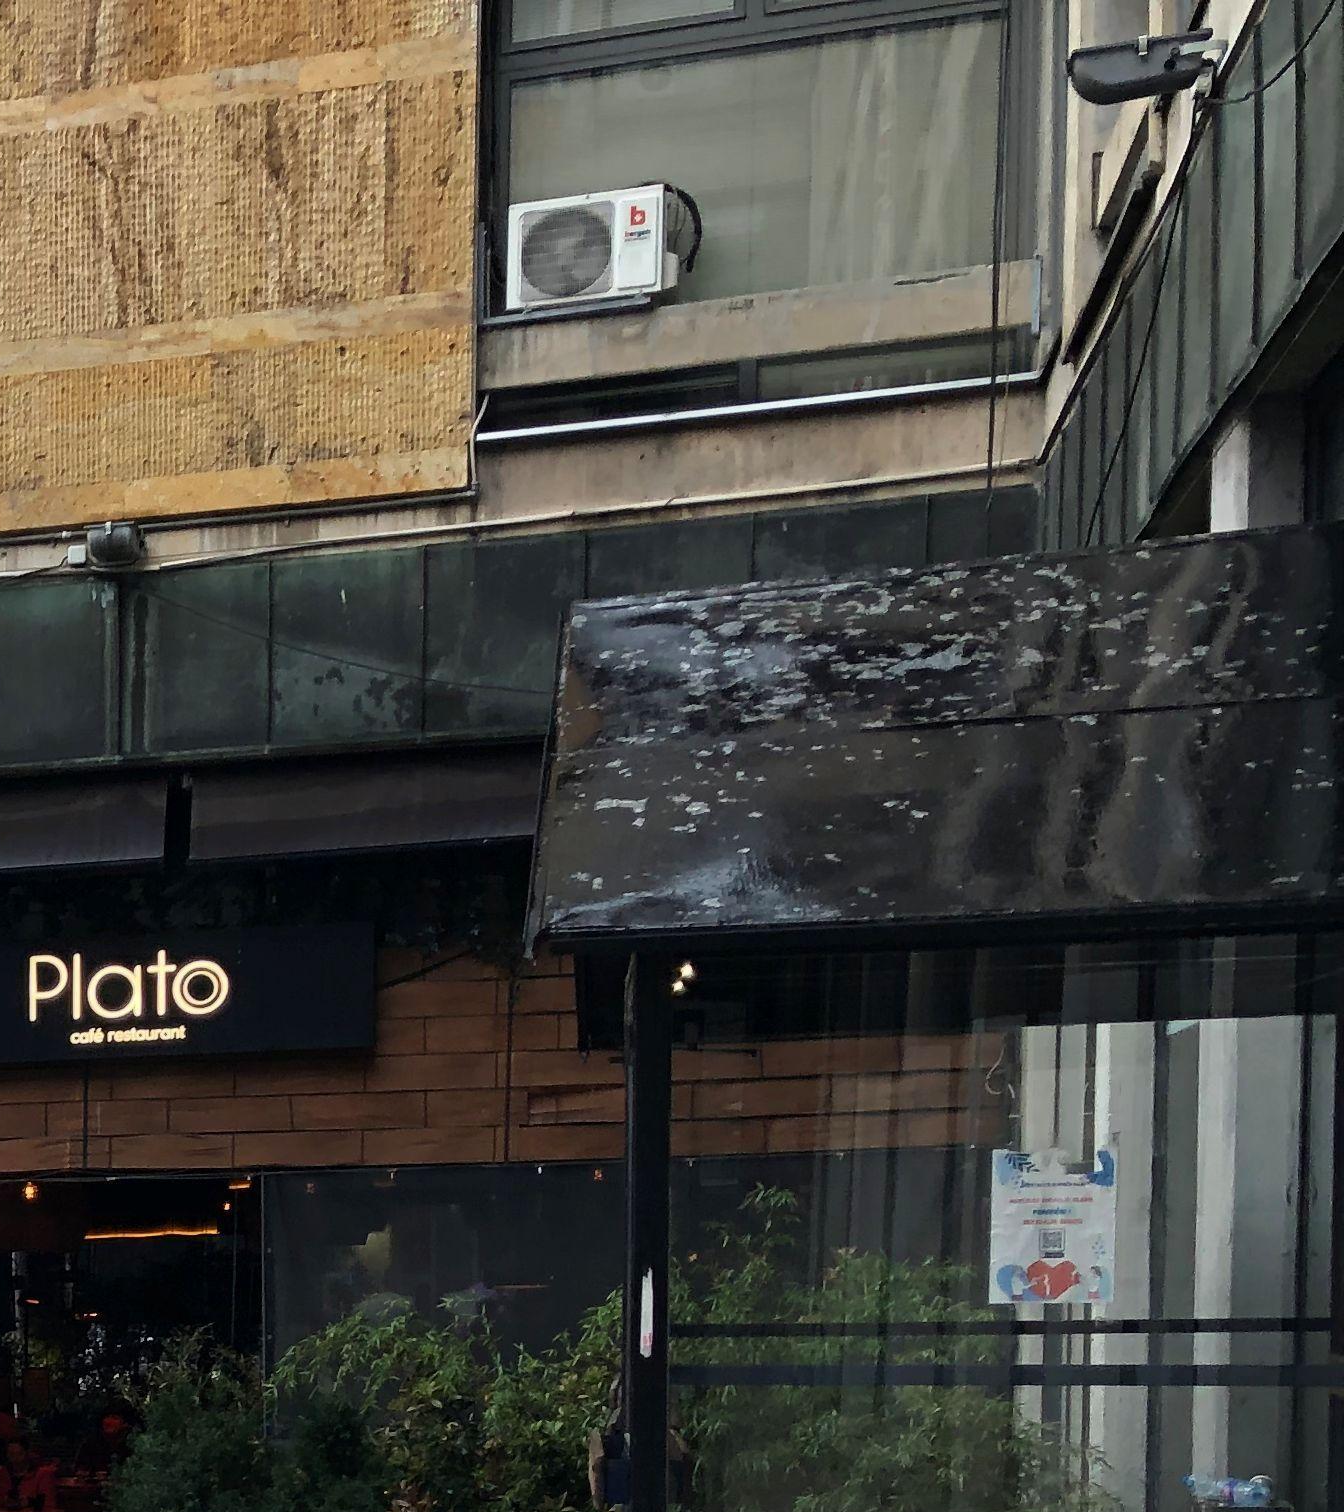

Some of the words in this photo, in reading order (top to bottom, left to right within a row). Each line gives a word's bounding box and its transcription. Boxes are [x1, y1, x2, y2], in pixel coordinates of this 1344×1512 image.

[28, 949, 230, 1022] Plato
[70, 1027, 104, 1045] café
[107, 1024, 187, 1042] restaurant
